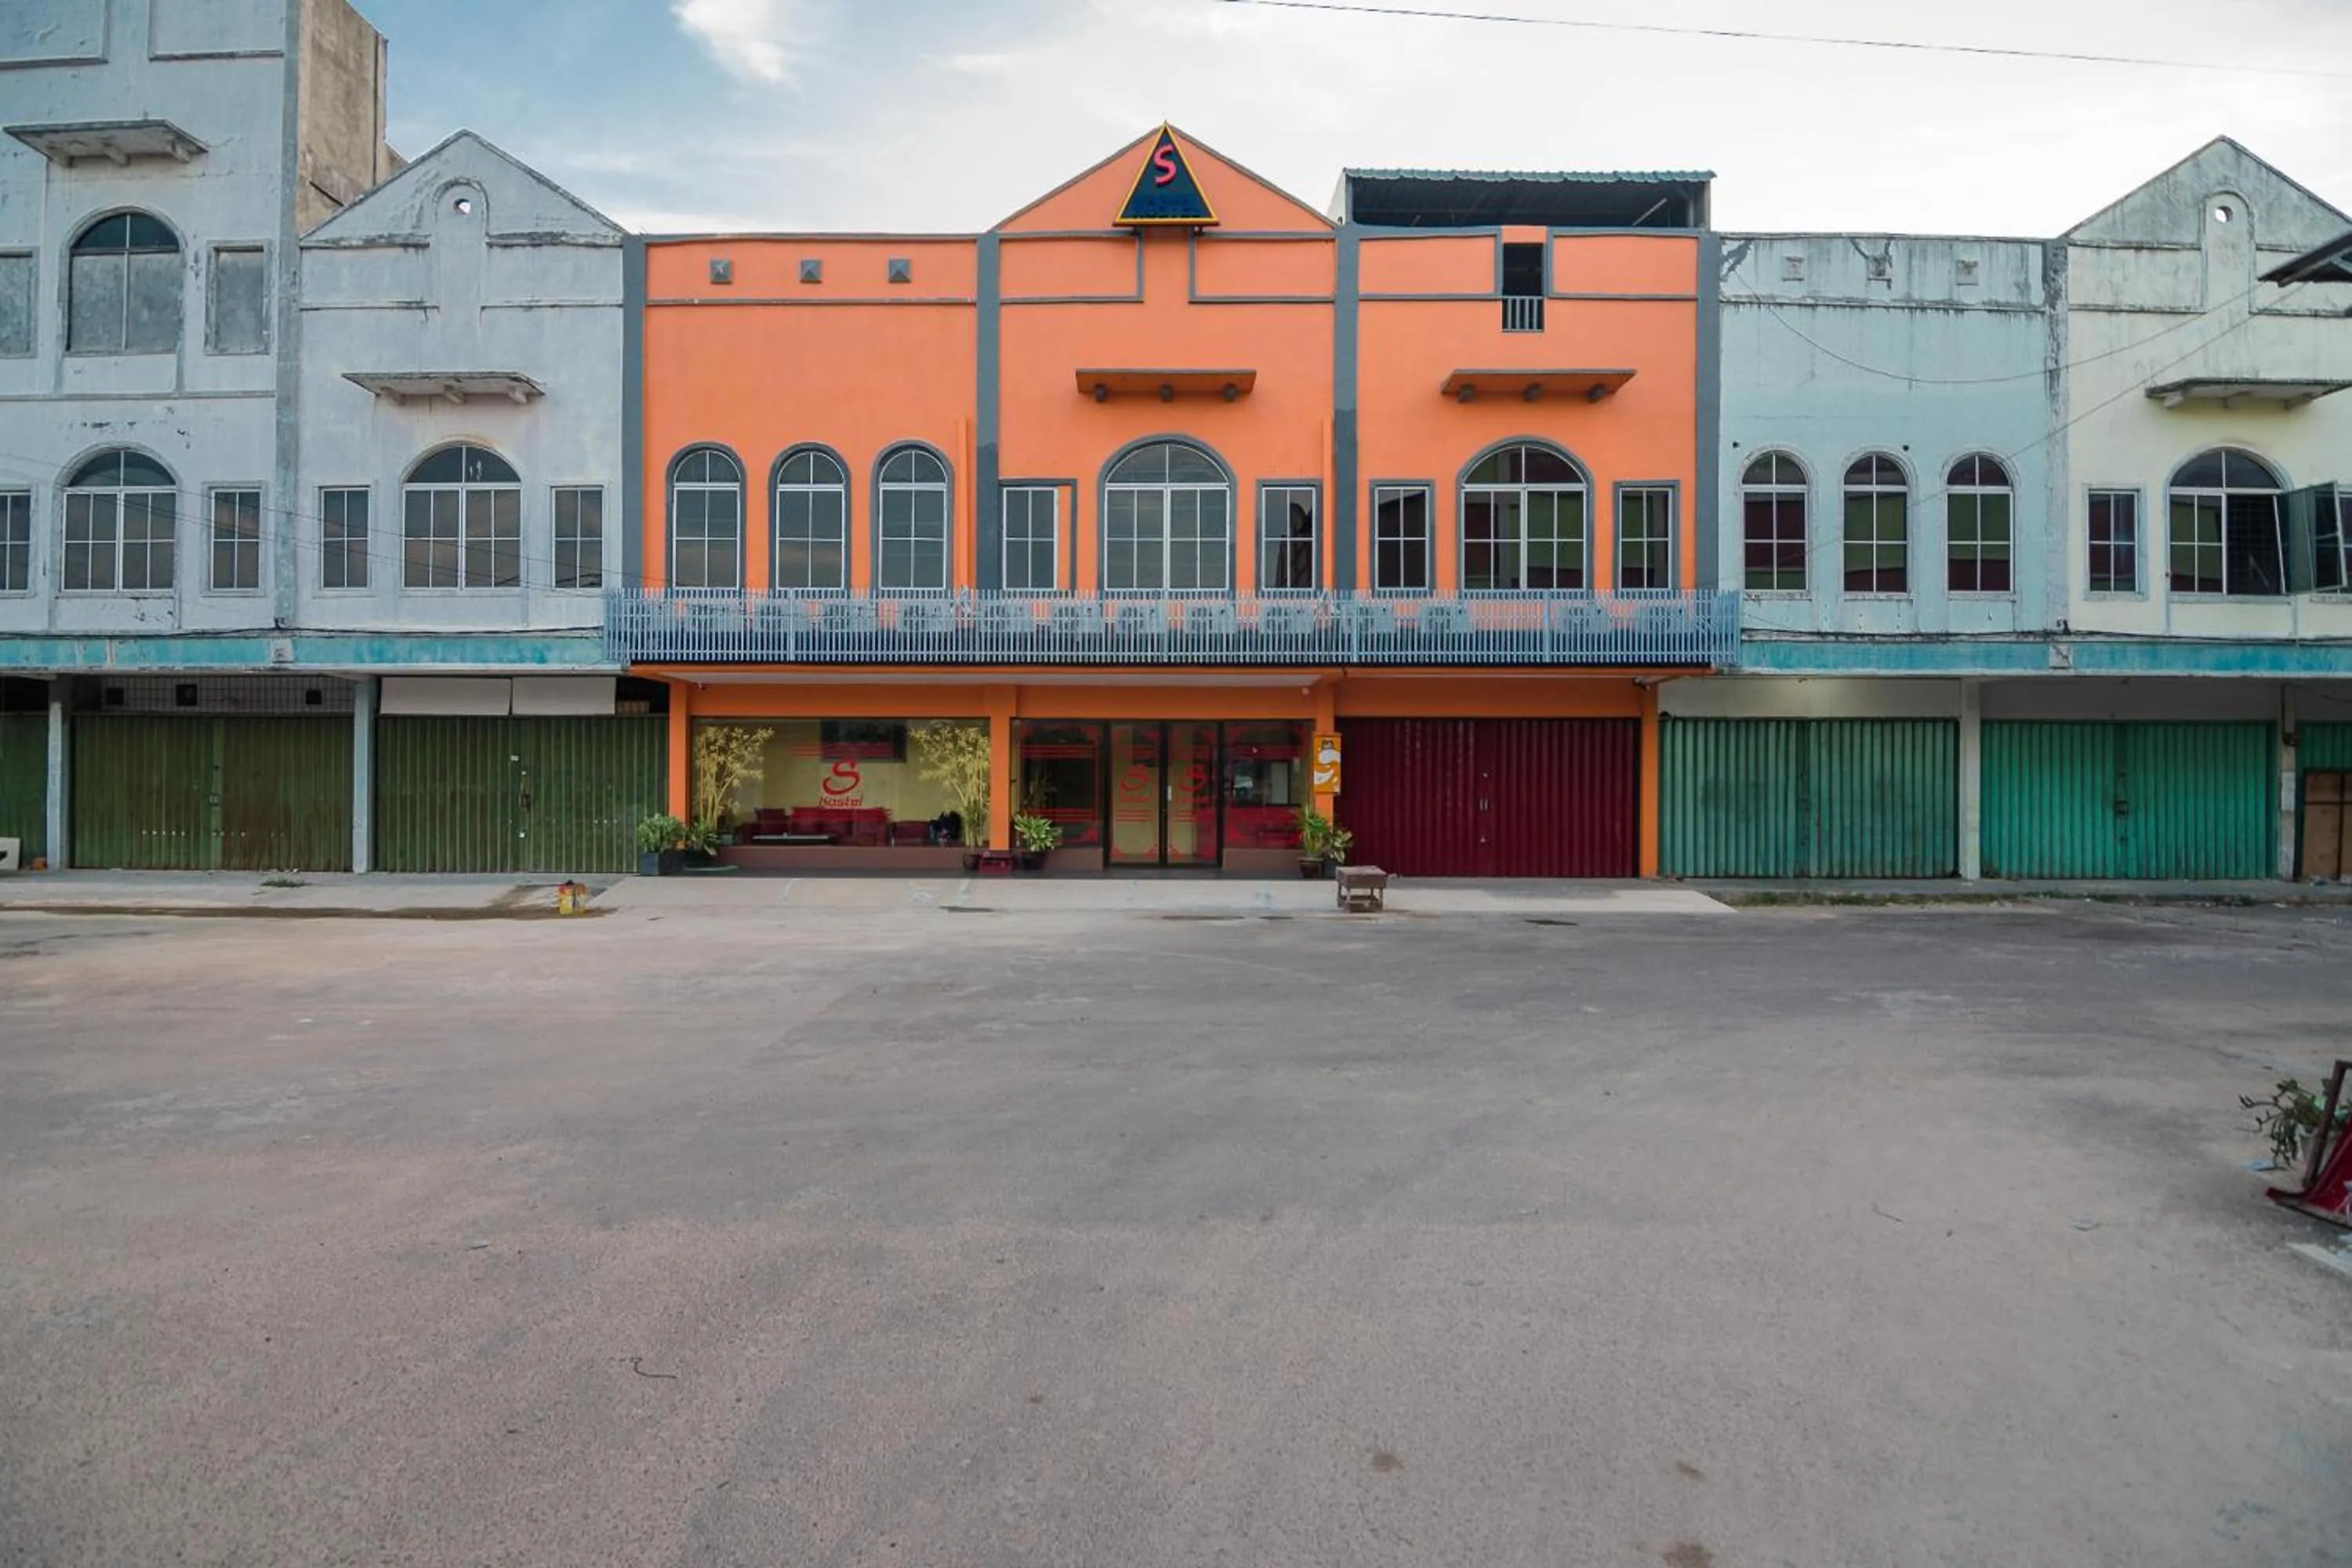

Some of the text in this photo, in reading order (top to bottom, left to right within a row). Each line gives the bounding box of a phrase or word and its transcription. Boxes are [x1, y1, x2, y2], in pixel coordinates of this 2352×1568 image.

[1153, 144, 1176, 185] S
[822, 759, 859, 796] S
[1120, 764, 1150, 791] S
